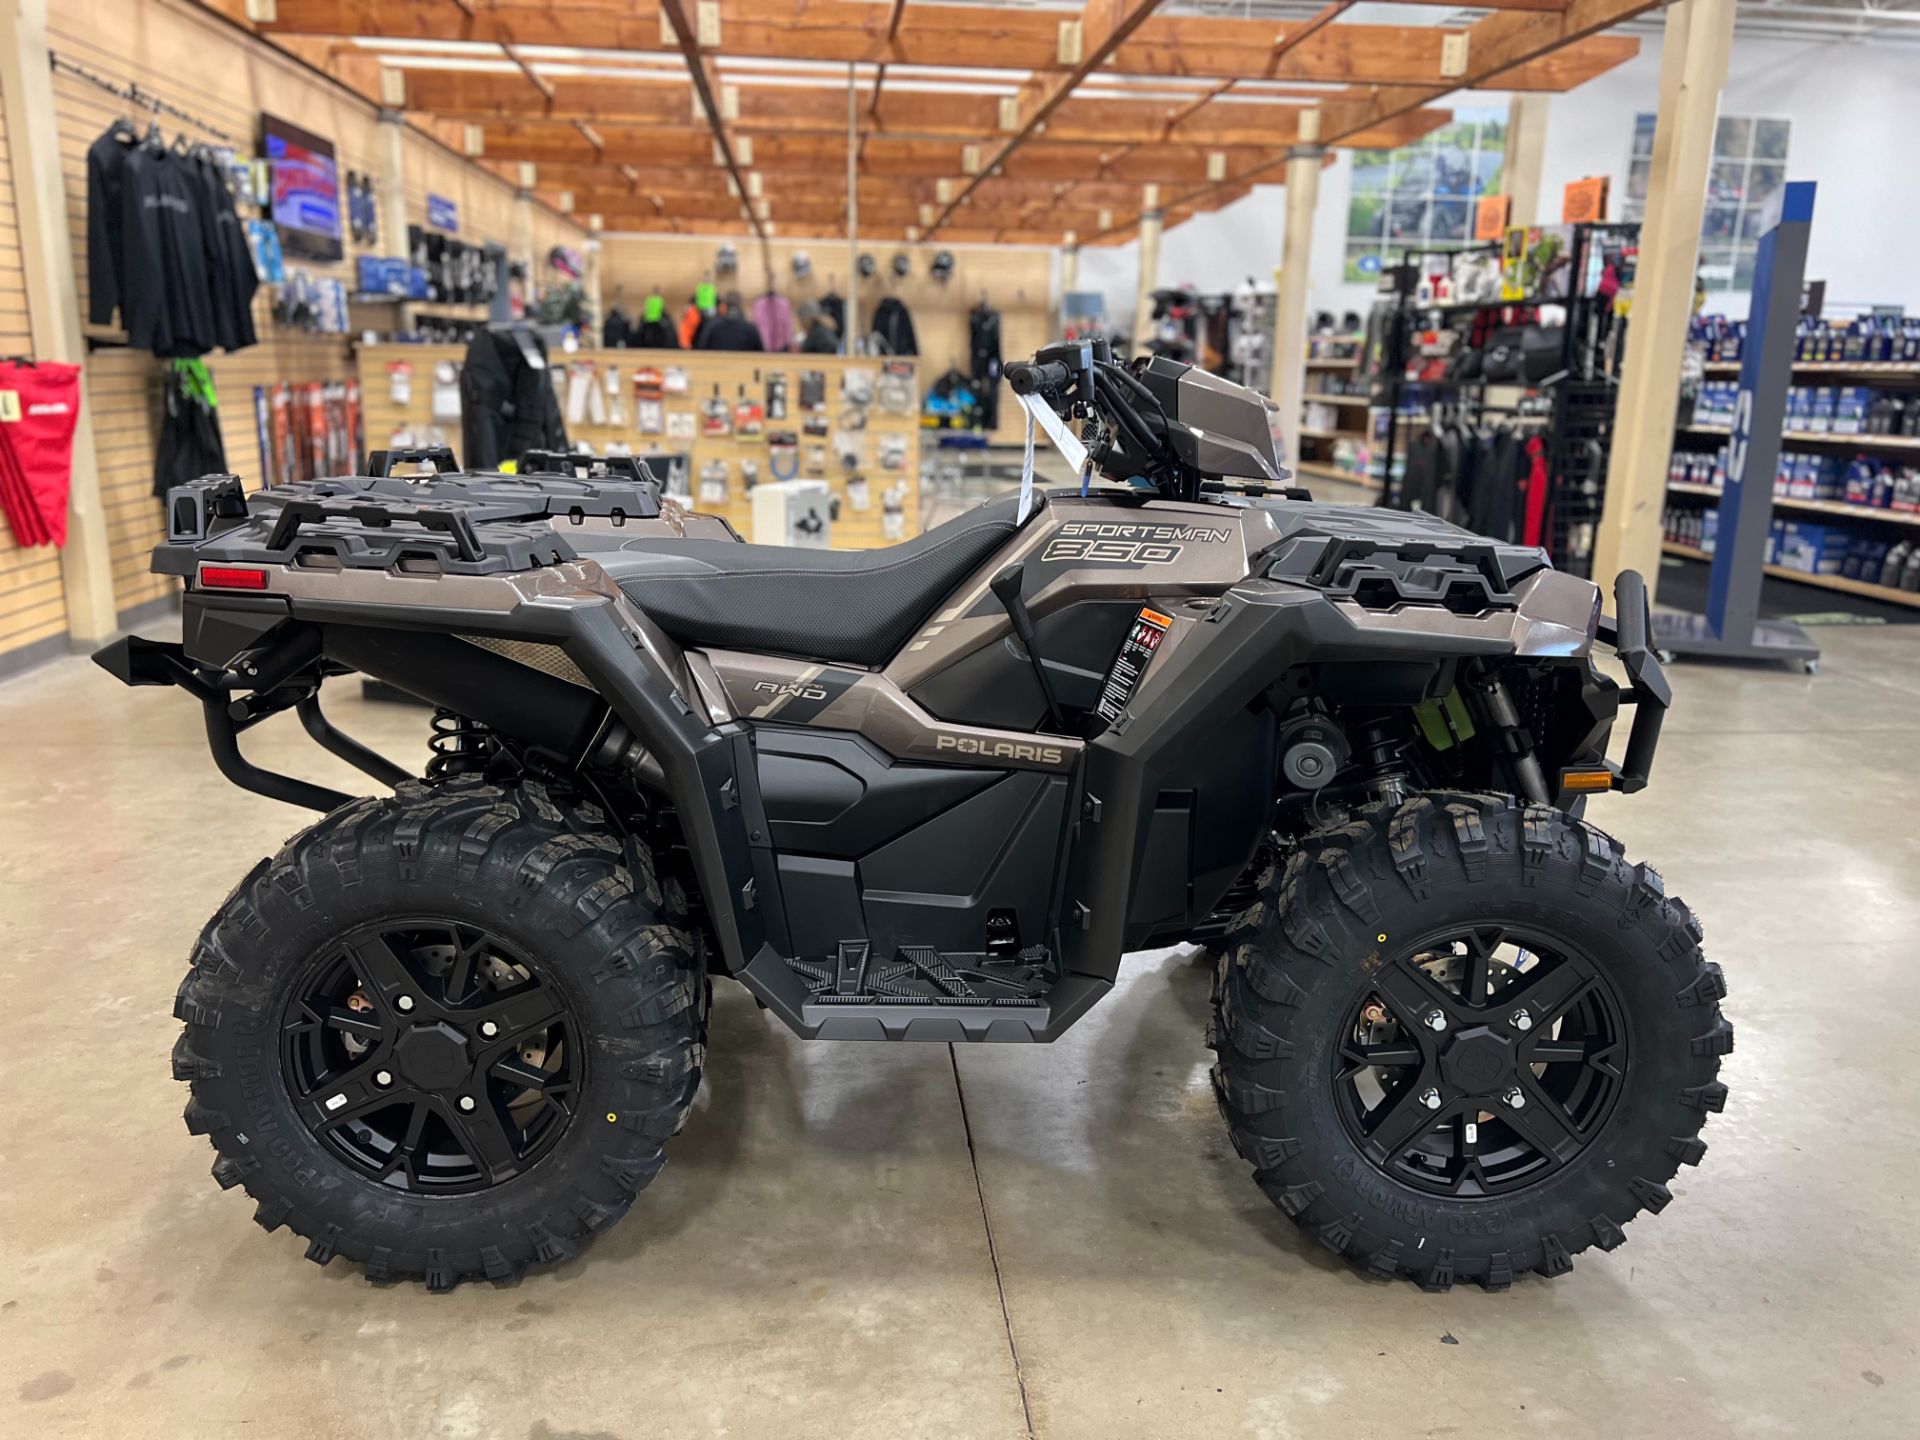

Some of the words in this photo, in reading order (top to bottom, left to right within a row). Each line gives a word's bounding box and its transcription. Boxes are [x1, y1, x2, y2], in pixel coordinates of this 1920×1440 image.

[1060, 523, 1231, 544] SPORTSMAN
[1041, 539, 1184, 564] 850
[753, 680, 828, 700] AWD
[936, 735, 1062, 764] POLARIS
